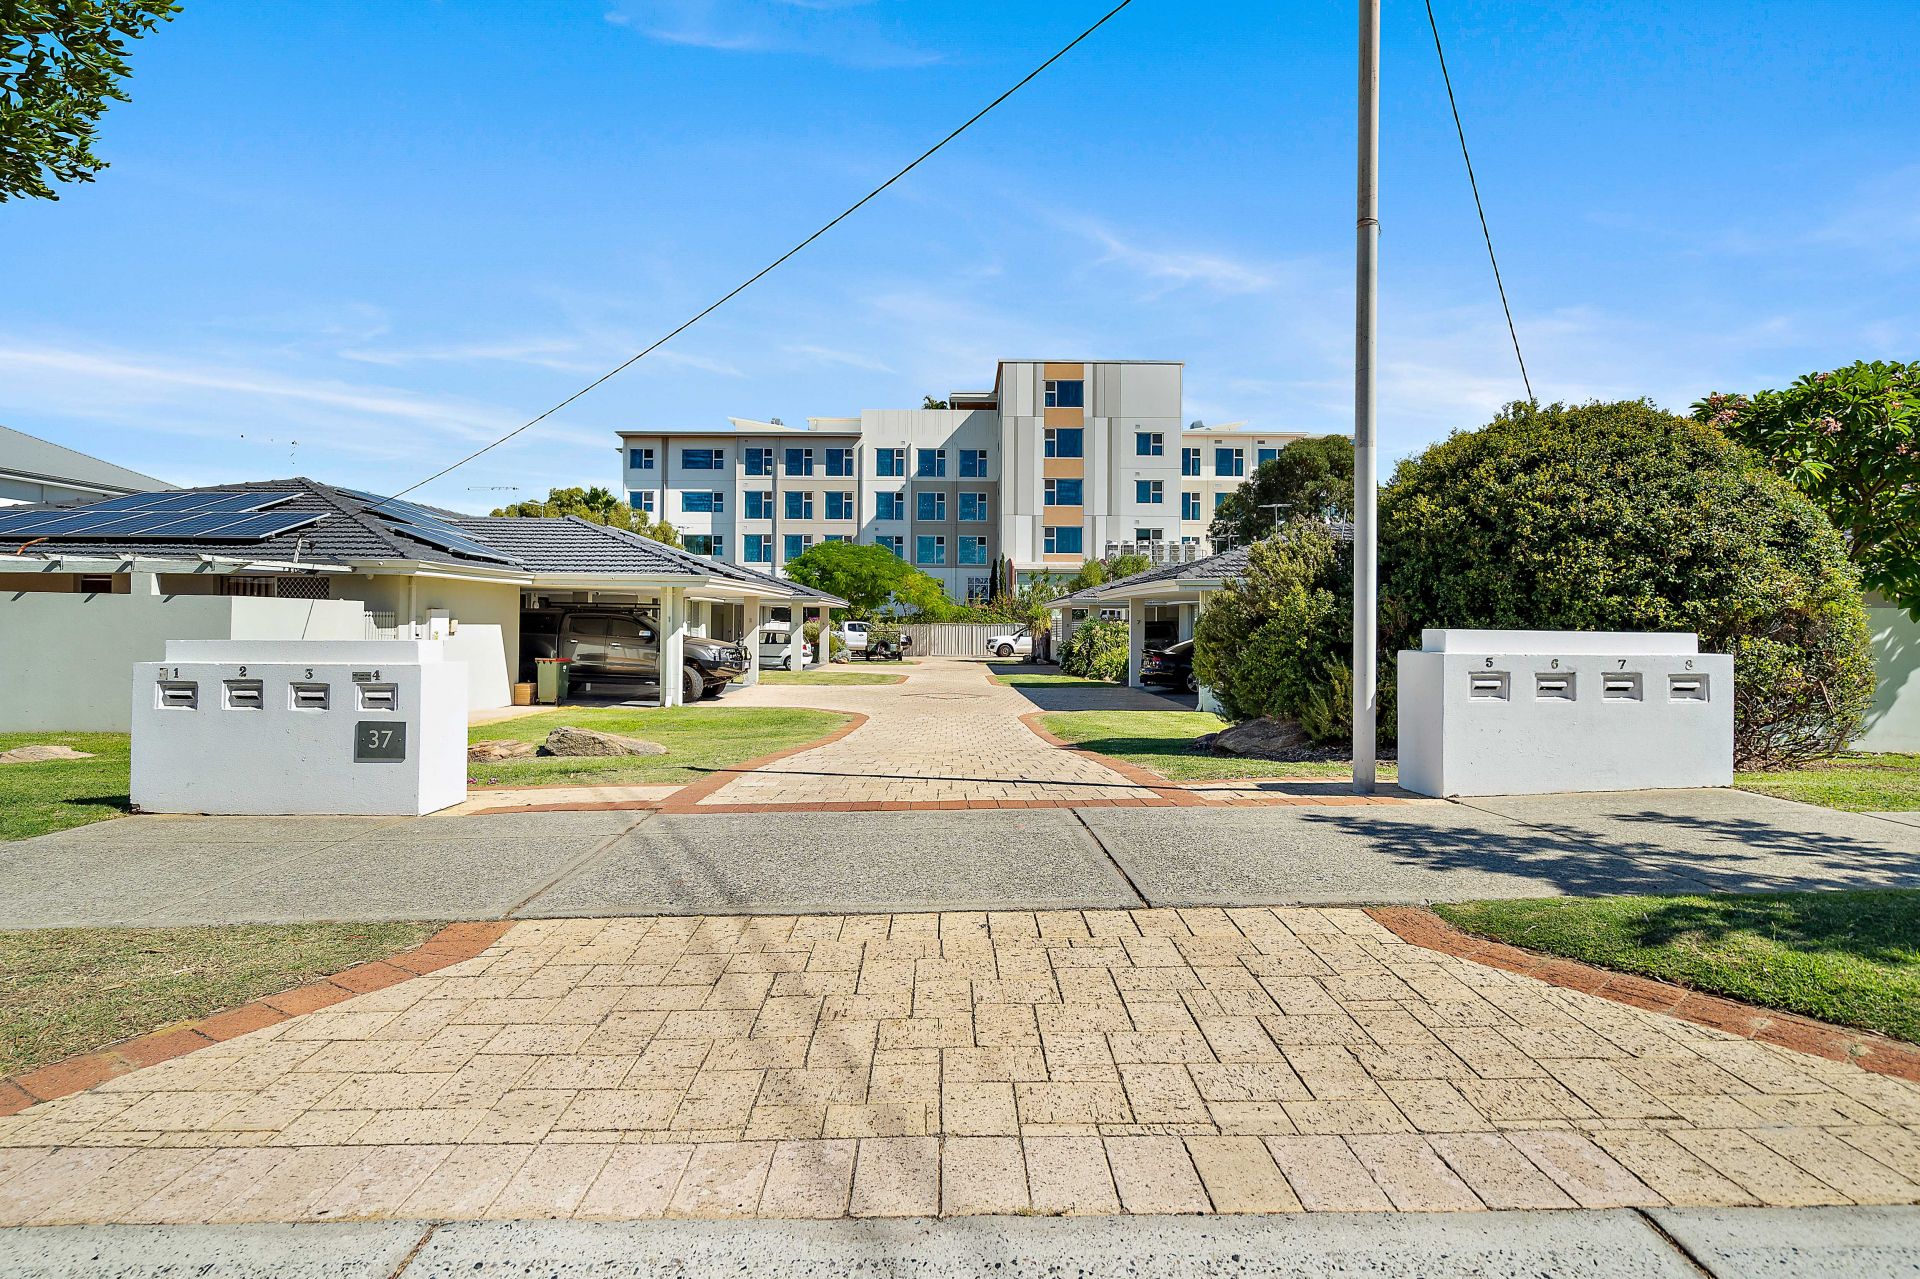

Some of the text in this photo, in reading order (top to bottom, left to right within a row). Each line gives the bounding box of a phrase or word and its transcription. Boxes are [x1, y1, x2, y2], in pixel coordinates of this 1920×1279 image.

[1485, 657, 1494, 668] 5
[1550, 658, 1559, 669] 6
[1617, 659, 1627, 669] 7
[1684, 659, 1693, 670] 8
[173, 667, 179, 678] 1
[239, 666, 247, 677] 2
[304, 668, 313, 679] 3
[372, 670, 380, 680] 4
[368, 730, 393, 749] 37
